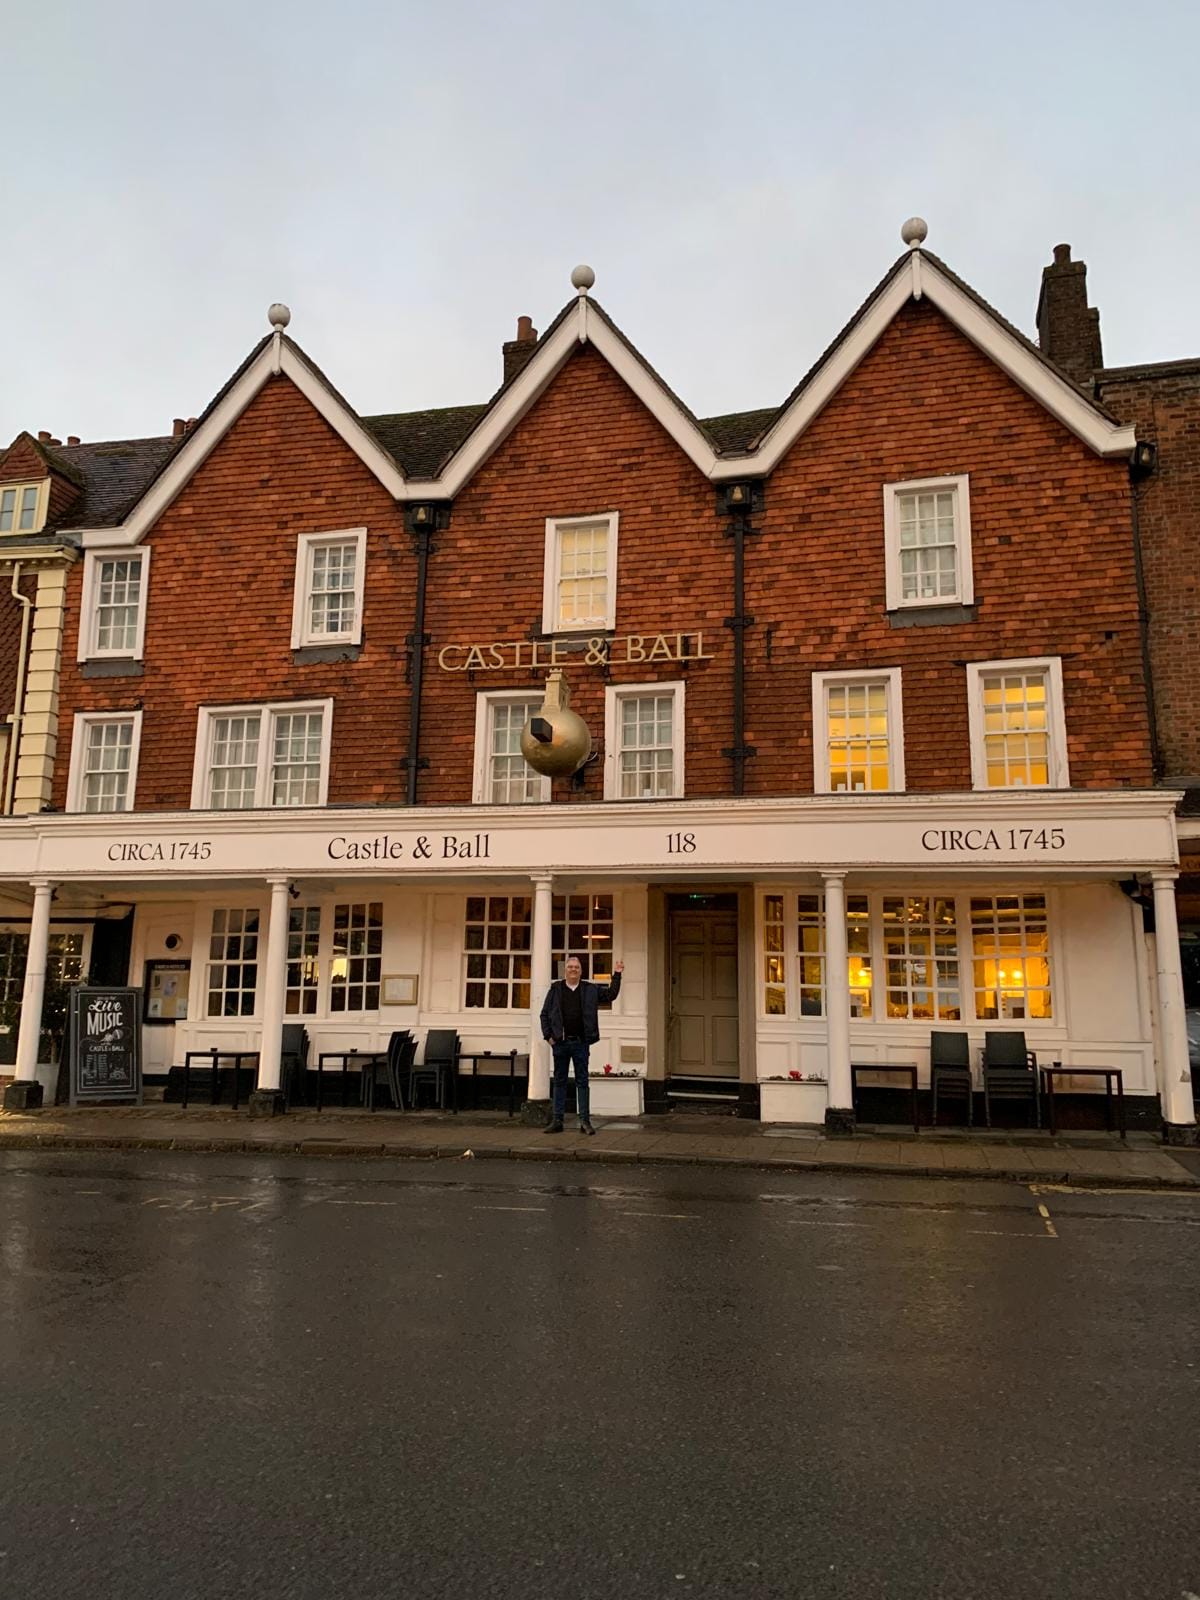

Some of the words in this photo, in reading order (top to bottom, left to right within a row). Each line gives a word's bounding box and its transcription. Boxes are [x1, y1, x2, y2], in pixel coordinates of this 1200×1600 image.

[438, 639, 569, 671] CASTLE
[584, 637, 608, 665] &
[626, 631, 715, 662] BALL
[327, 835, 403, 860] Castle
[412, 835, 433, 860] &
[441, 833, 491, 859] Ball
[667, 832, 697, 854] 118
[921, 829, 1002, 851] CIRCA
[1007, 828, 1066, 850] 1745
[107, 842, 165, 862] CIRCA
[170, 841, 212, 861] 1745
[88, 1000, 122, 1012] Live
[87, 1012, 123, 1035] MUSIC
